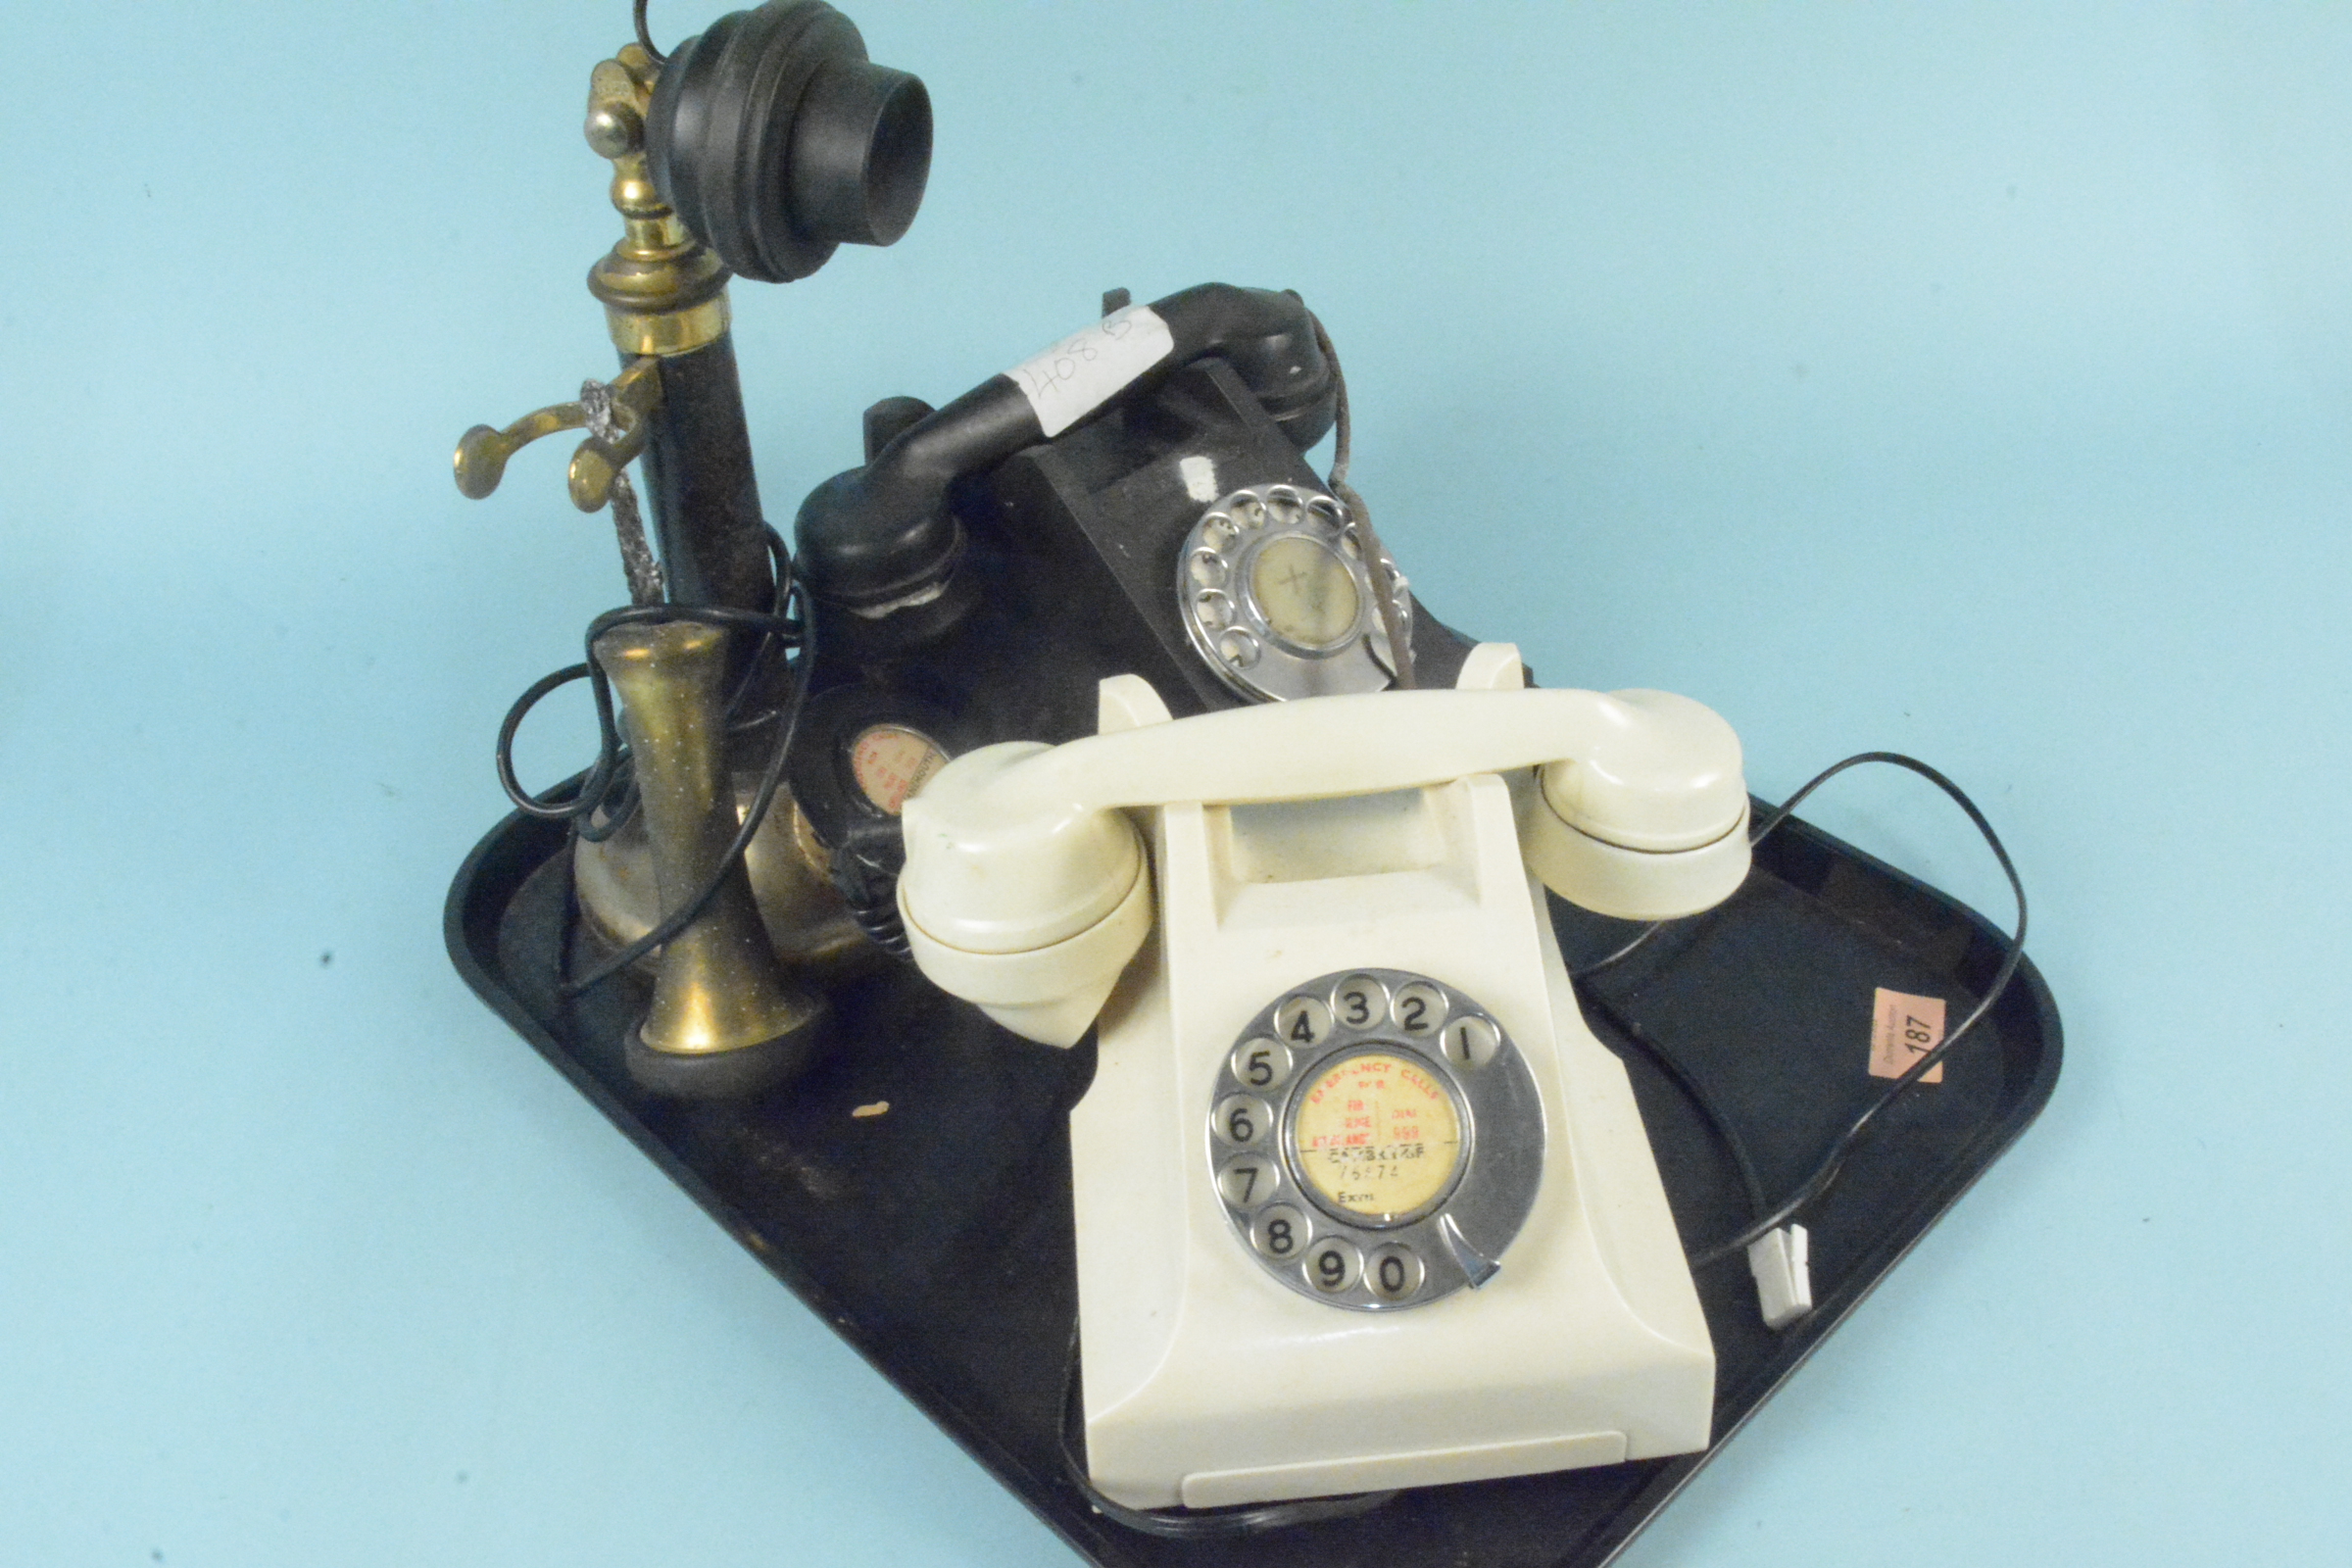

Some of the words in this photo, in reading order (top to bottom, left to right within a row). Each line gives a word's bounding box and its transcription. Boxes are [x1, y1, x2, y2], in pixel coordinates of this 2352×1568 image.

[1344, 992, 1369, 1024] 3
[1402, 997, 1429, 1031] 2
[1291, 1010, 1315, 1043] 4
[1459, 1027, 1471, 1059] 1
[1904, 1014, 1933, 1054] 187
[1249, 1051, 1273, 1086] 5
[1229, 1107, 1254, 1142] 6
[1235, 1167, 1259, 1203] 7
[1268, 1219, 1294, 1254] 8
[1318, 1250, 1346, 1287] 9
[1379, 1255, 1405, 1293] 0
